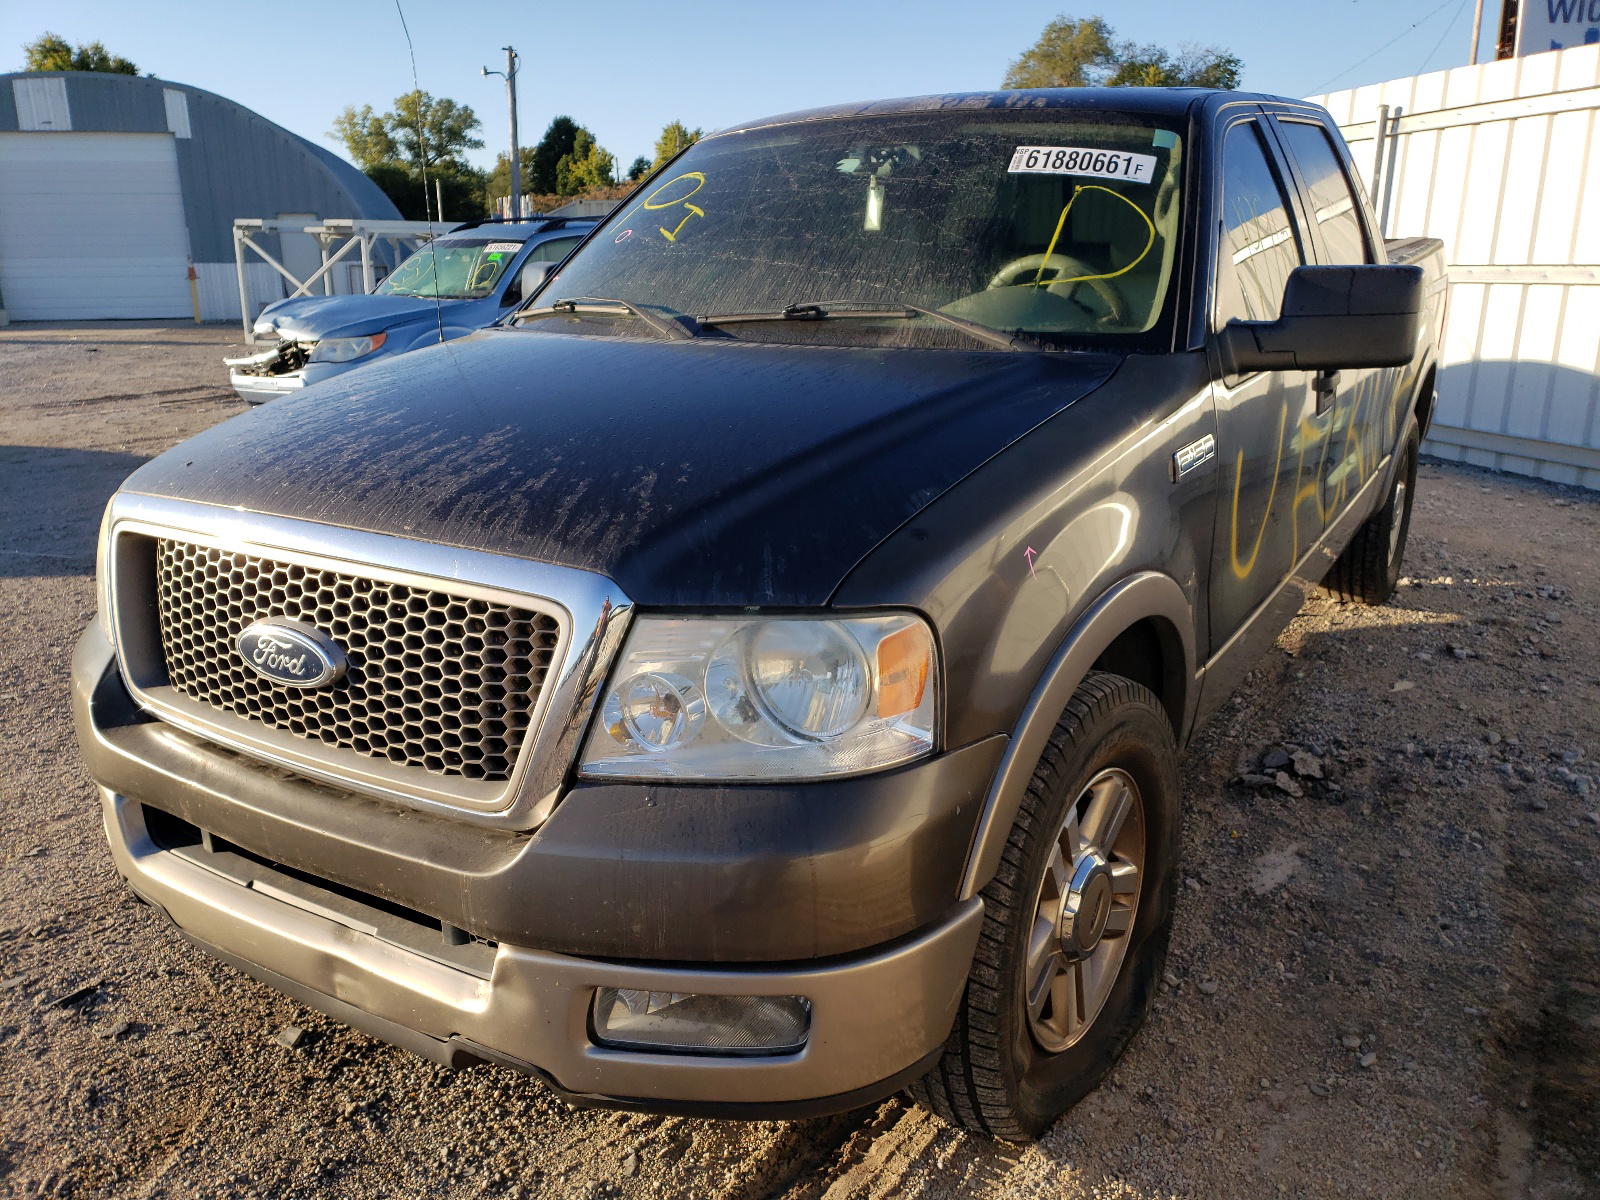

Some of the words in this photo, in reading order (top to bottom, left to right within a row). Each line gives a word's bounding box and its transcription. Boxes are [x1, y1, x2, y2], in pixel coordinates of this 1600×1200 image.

[1025, 149, 1133, 176] 61880661
[1134, 164, 1144, 175] F
[253, 635, 306, 676] Ford
